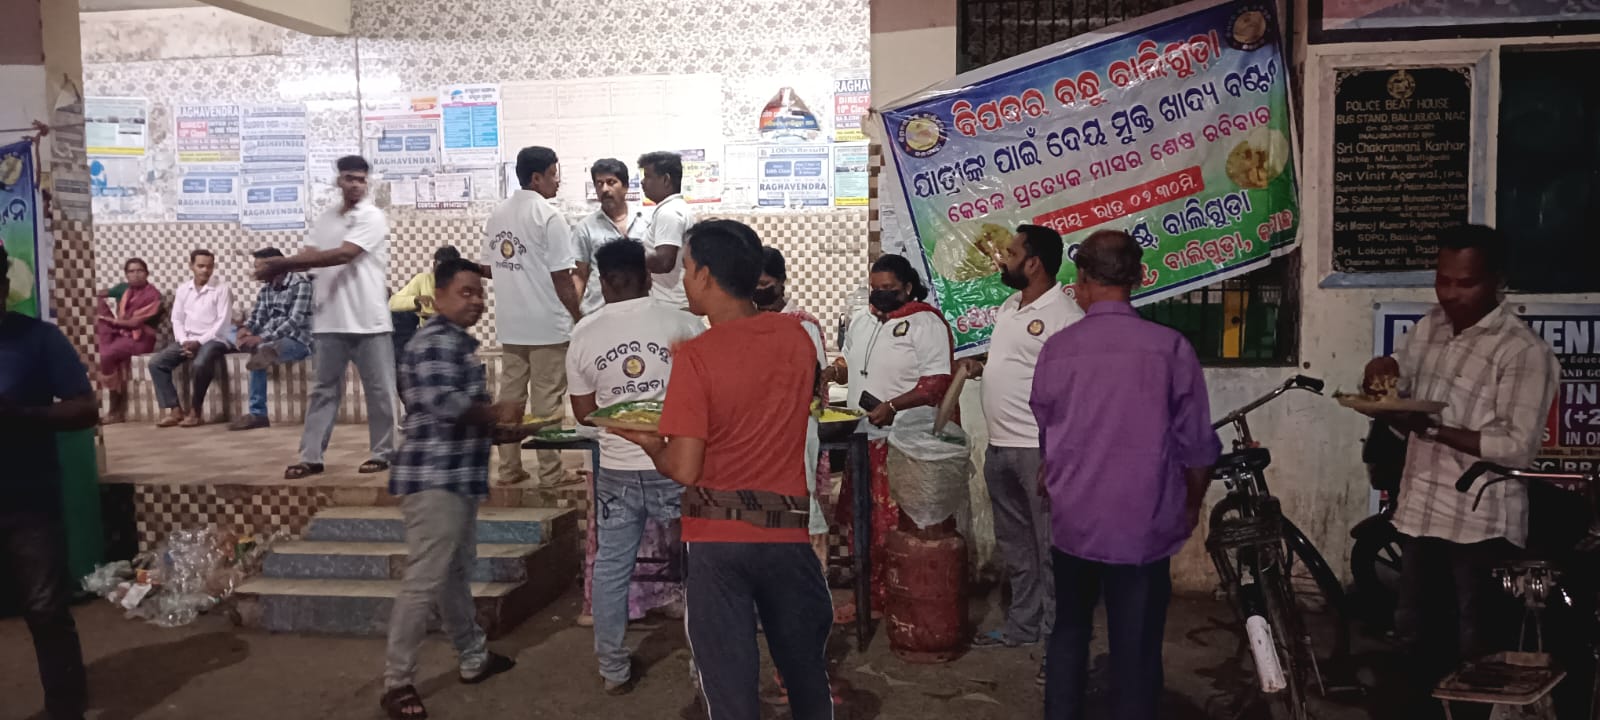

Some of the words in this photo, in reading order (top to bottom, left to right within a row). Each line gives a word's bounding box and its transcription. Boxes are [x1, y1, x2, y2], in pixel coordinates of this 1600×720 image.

[838, 95, 869, 104] DIRECT
[1345, 99, 1381, 112] POLICE
[1385, 98, 1413, 110] BEAT
[1417, 97, 1449, 109] HOUSE
[1336, 114, 1355, 125] BUS
[993, 126, 1042, 175] ପାଇଁ
[1159, 81, 1220, 121] ଖାଦ୍ୟ
[1089, 150, 1144, 180] ମାସର
[1150, 131, 1196, 161] ଶେଷ
[1203, 106, 1271, 143] ରବିବାର
[1336, 142, 1352, 154] Sri
[1356, 141, 1421, 154] Chakramani
[373, 157, 436, 165] RAGHAVENDRA
[1335, 171, 1352, 182] Sri
[1356, 170, 1386, 181] Vinit
[760, 182, 827, 191] RAGHAVENDRA
[243, 207, 304, 216] RAGHAVENDRA
[595, 341, 641, 371] ବିପଦର
[1565, 431, 1581, 445] IN
